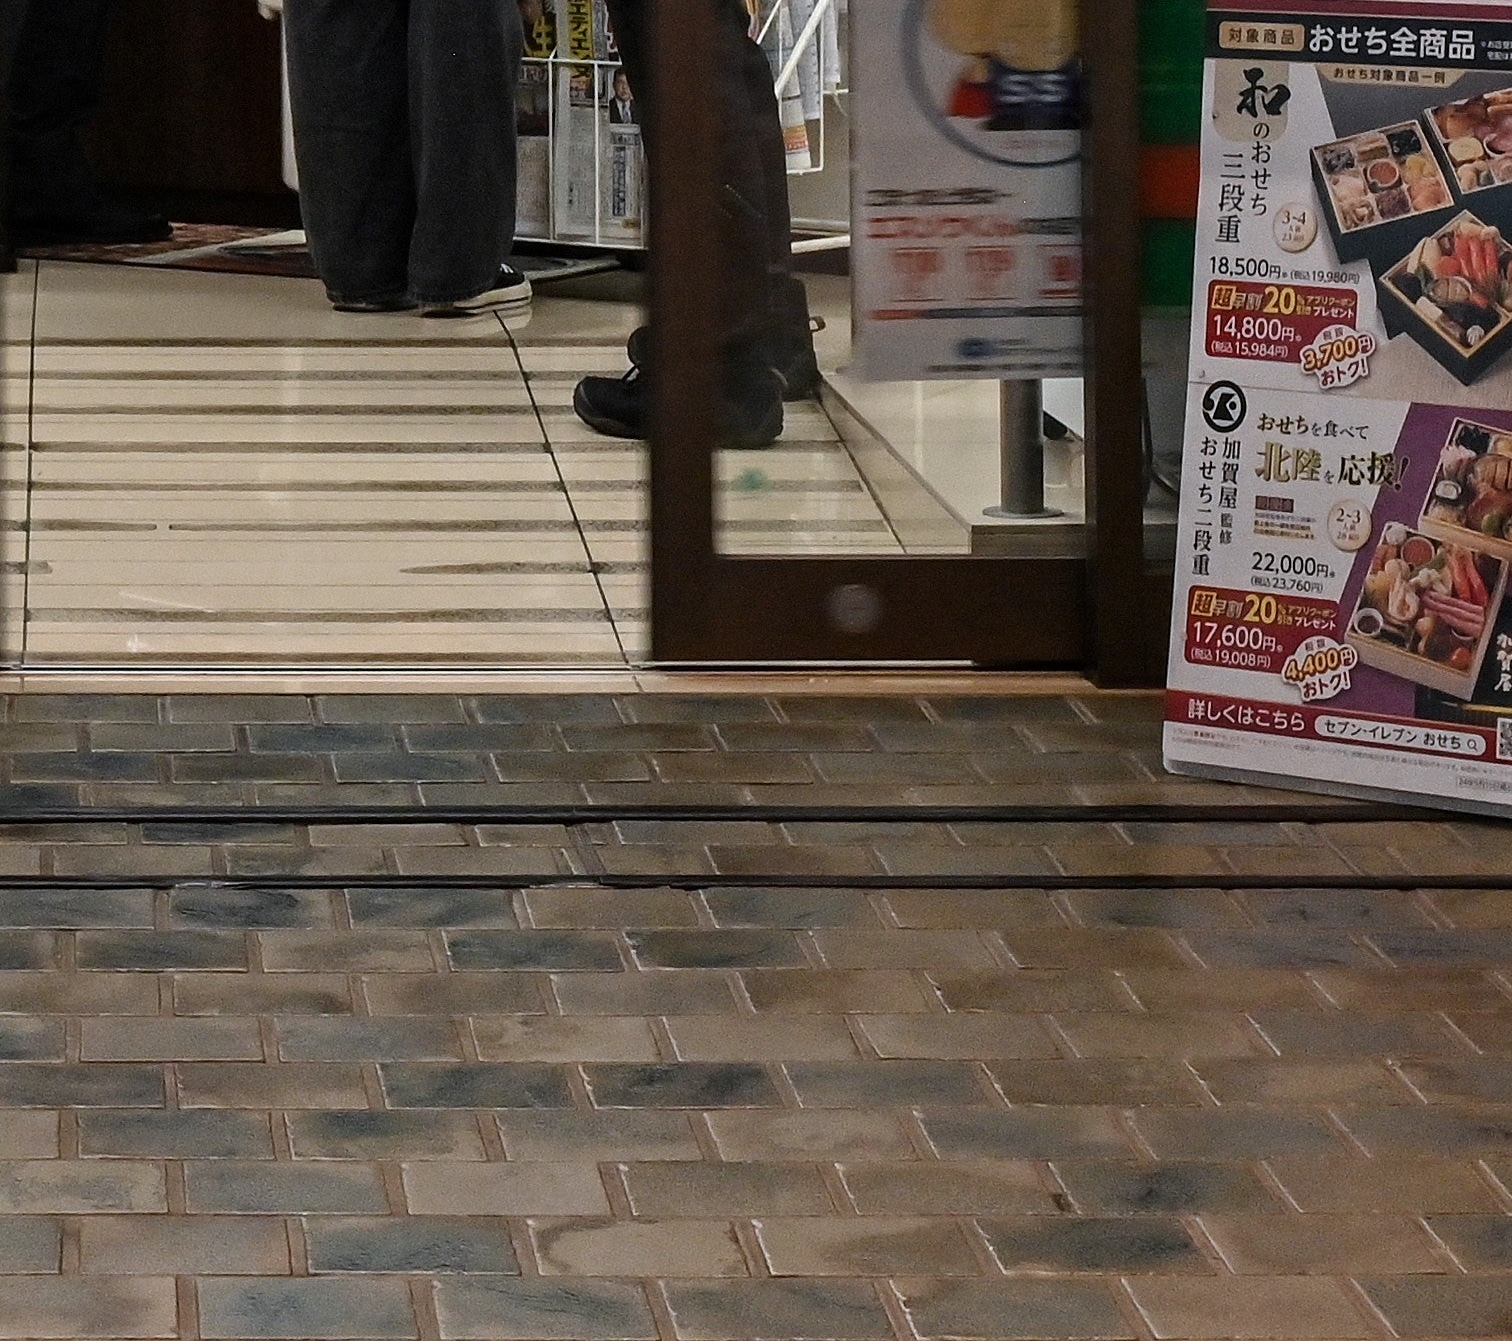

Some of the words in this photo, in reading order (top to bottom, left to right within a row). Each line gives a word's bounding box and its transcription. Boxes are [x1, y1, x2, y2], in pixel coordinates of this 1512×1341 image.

[1229, 28, 1296, 45] 対象商品
[1308, 23, 1476, 61] おせち全商品
[1333, 67, 1447, 85] おせち対象商品一例
[1215, 153, 1247, 244] 三段重
[1257, 413, 1369, 440] おせちを食べて
[1254, 441, 1411, 492] 北陸を応援!
[1191, 437, 1218, 576] おせち二段重
[1188, 699, 1305, 732] 詳しくはこちら
